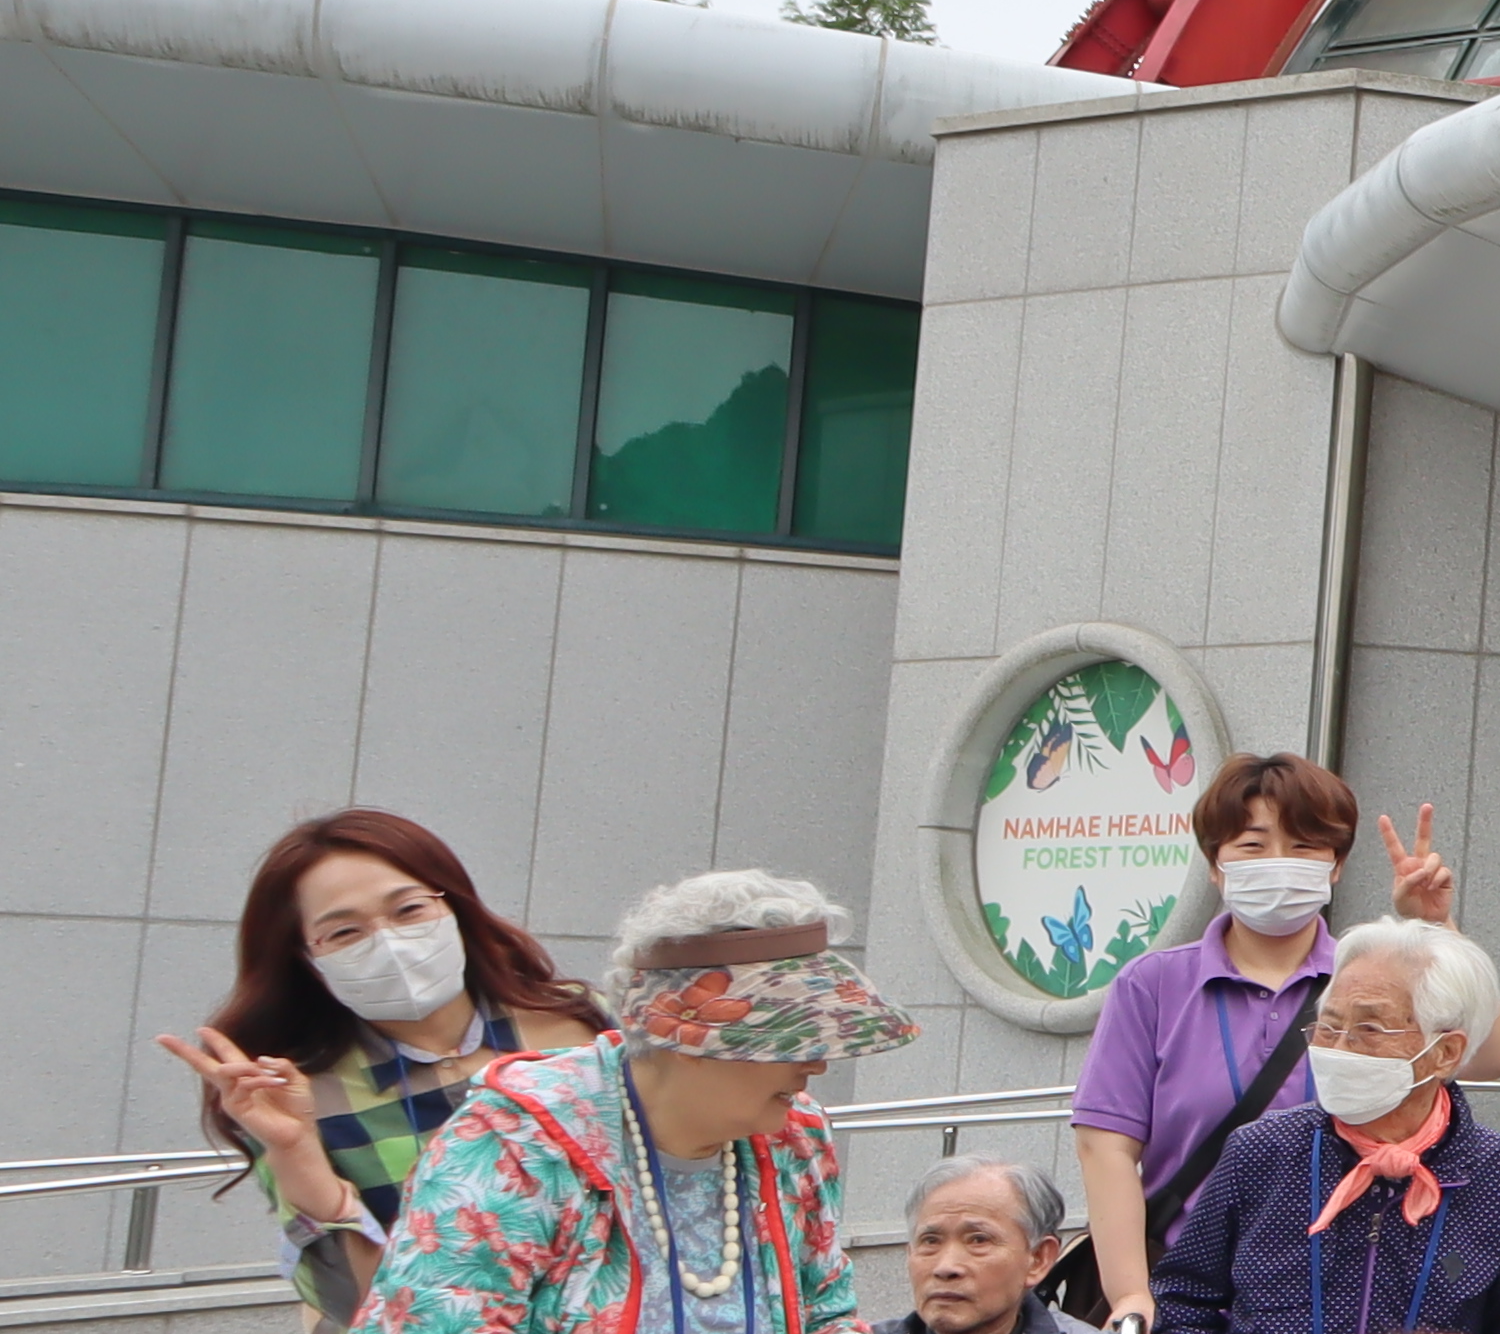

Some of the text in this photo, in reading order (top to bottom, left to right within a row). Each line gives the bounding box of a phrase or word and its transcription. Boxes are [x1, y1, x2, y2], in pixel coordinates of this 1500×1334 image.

[1003, 813, 1194, 840] NAMHAE HEALIN
[1023, 844, 1190, 870] FOREST TOWN
